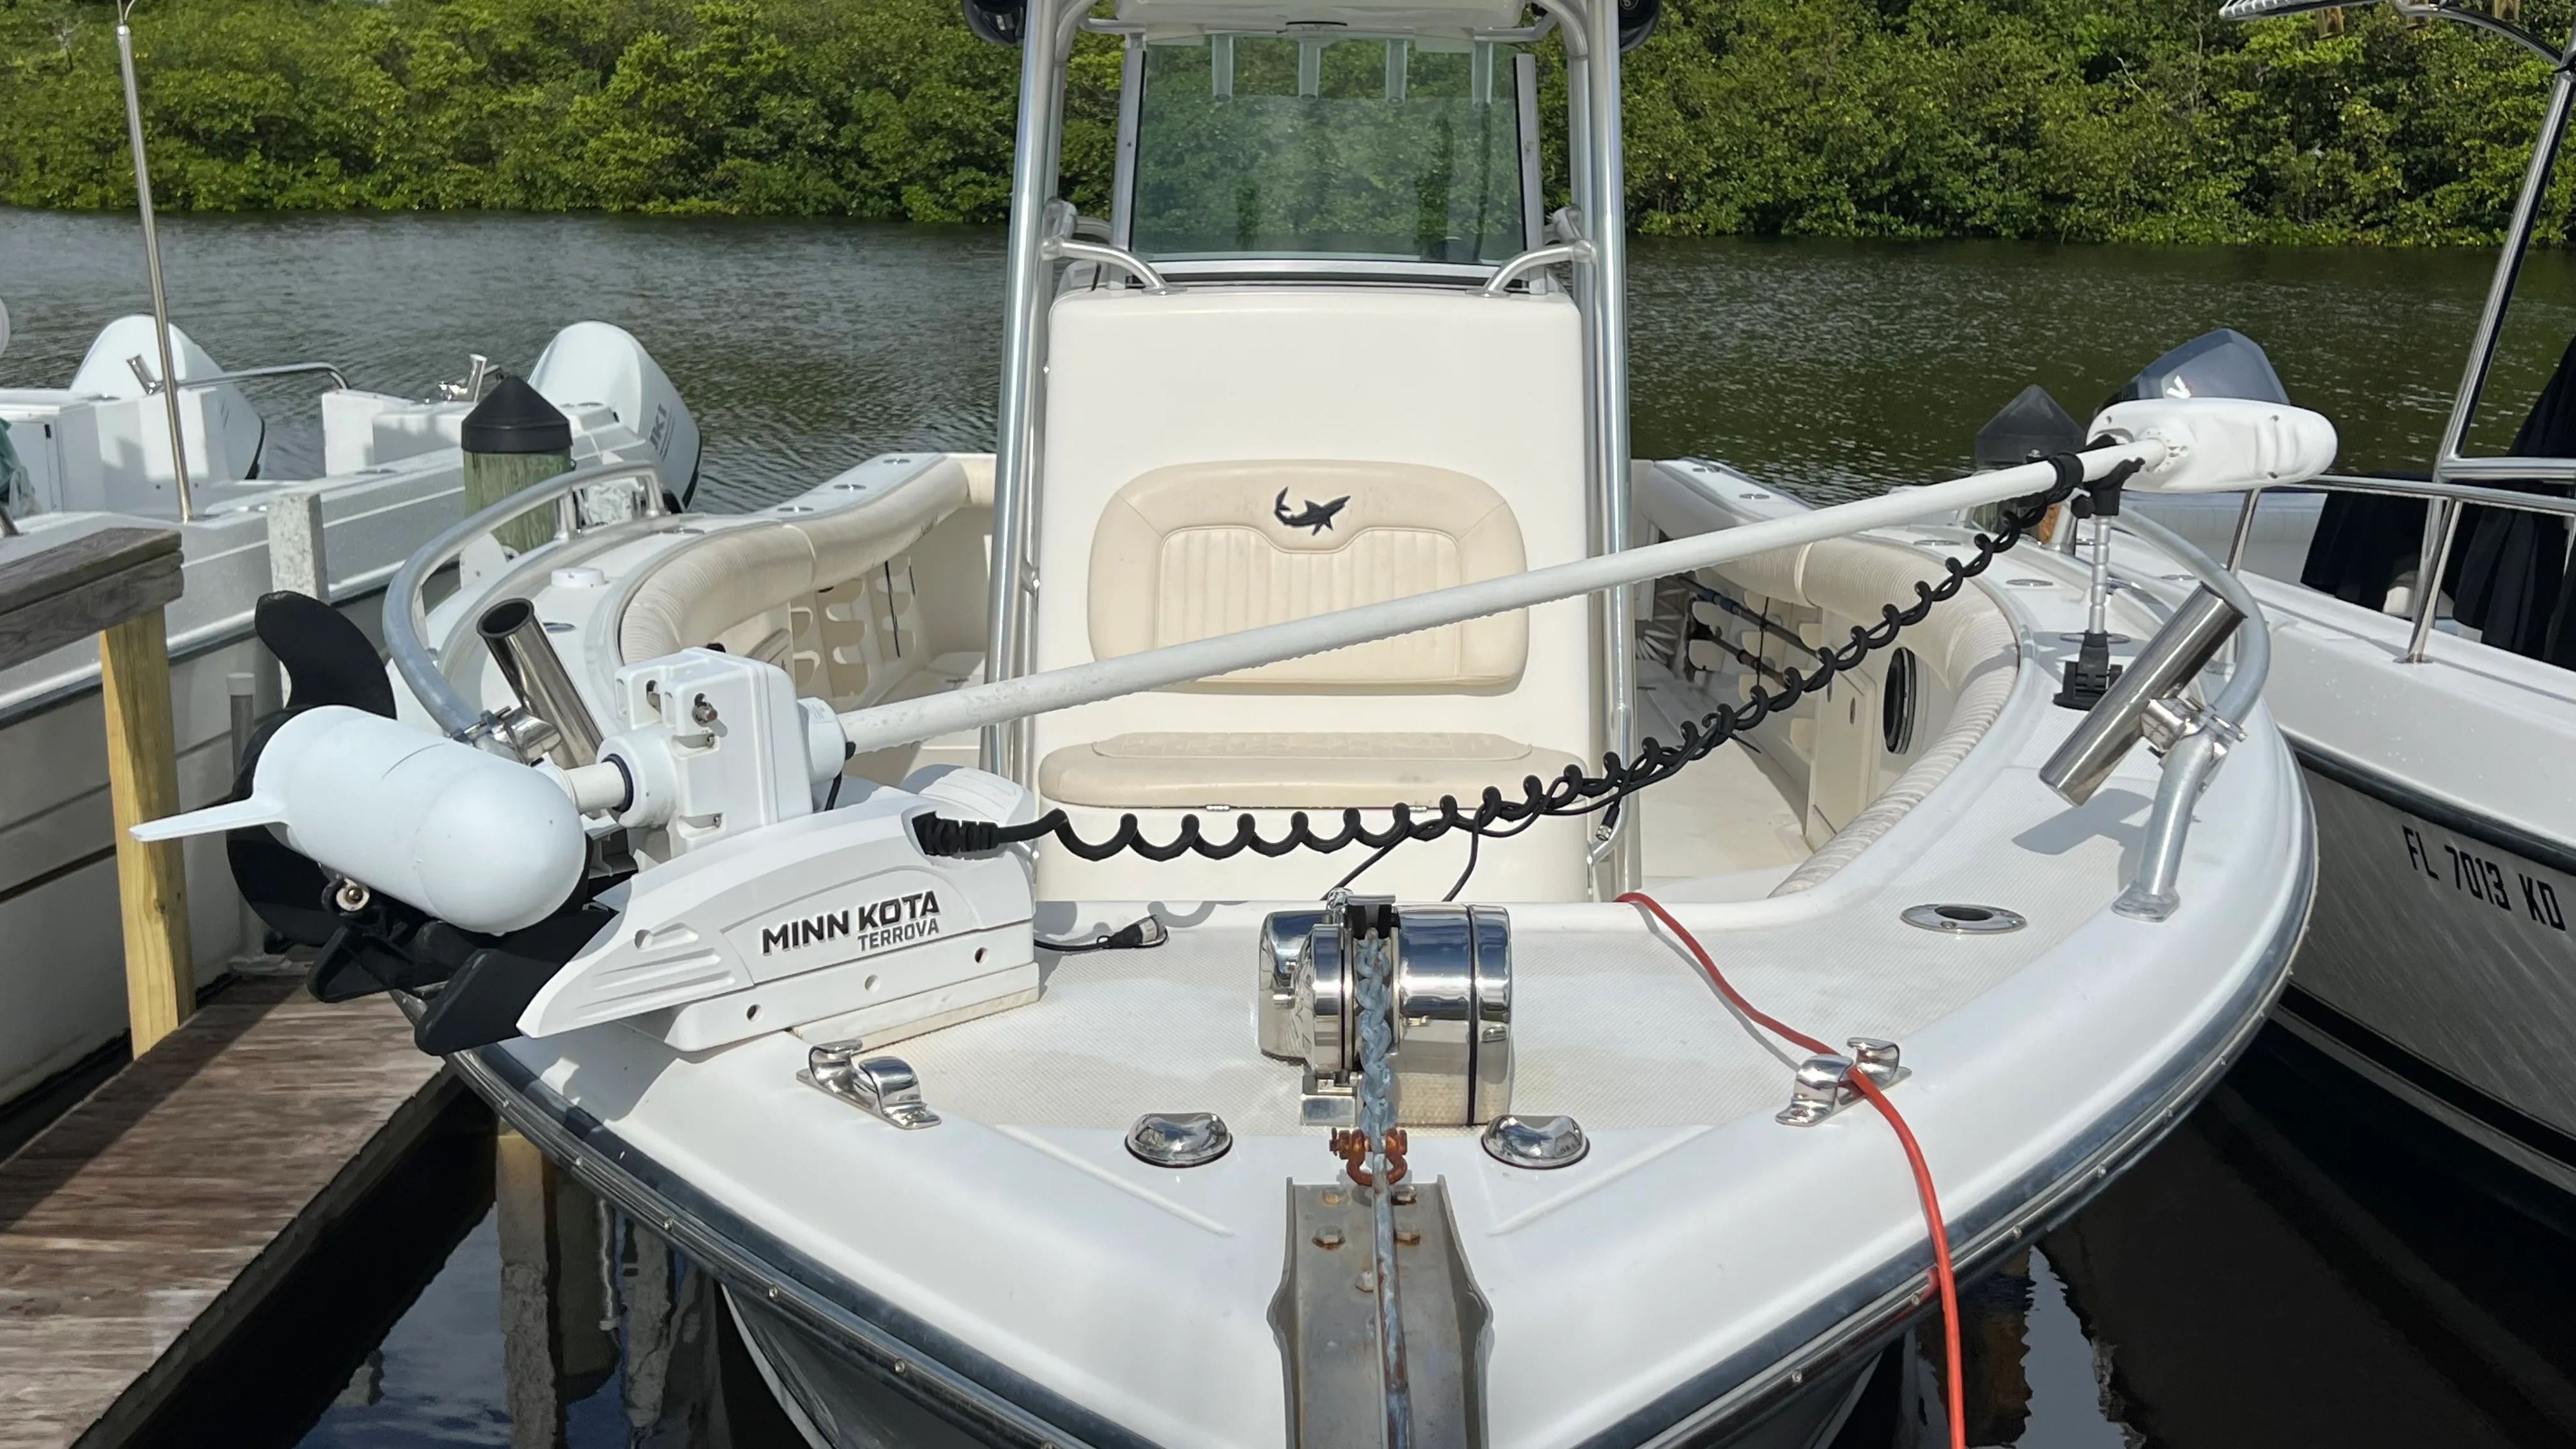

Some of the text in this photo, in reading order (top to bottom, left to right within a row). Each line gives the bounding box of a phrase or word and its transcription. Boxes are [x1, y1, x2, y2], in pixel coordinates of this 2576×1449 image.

[2402, 824, 2440, 881] FL
[2444, 844, 2511, 912] 7013
[762, 890, 940, 955] MINN KOTA
[857, 917, 940, 951] TERROVA
